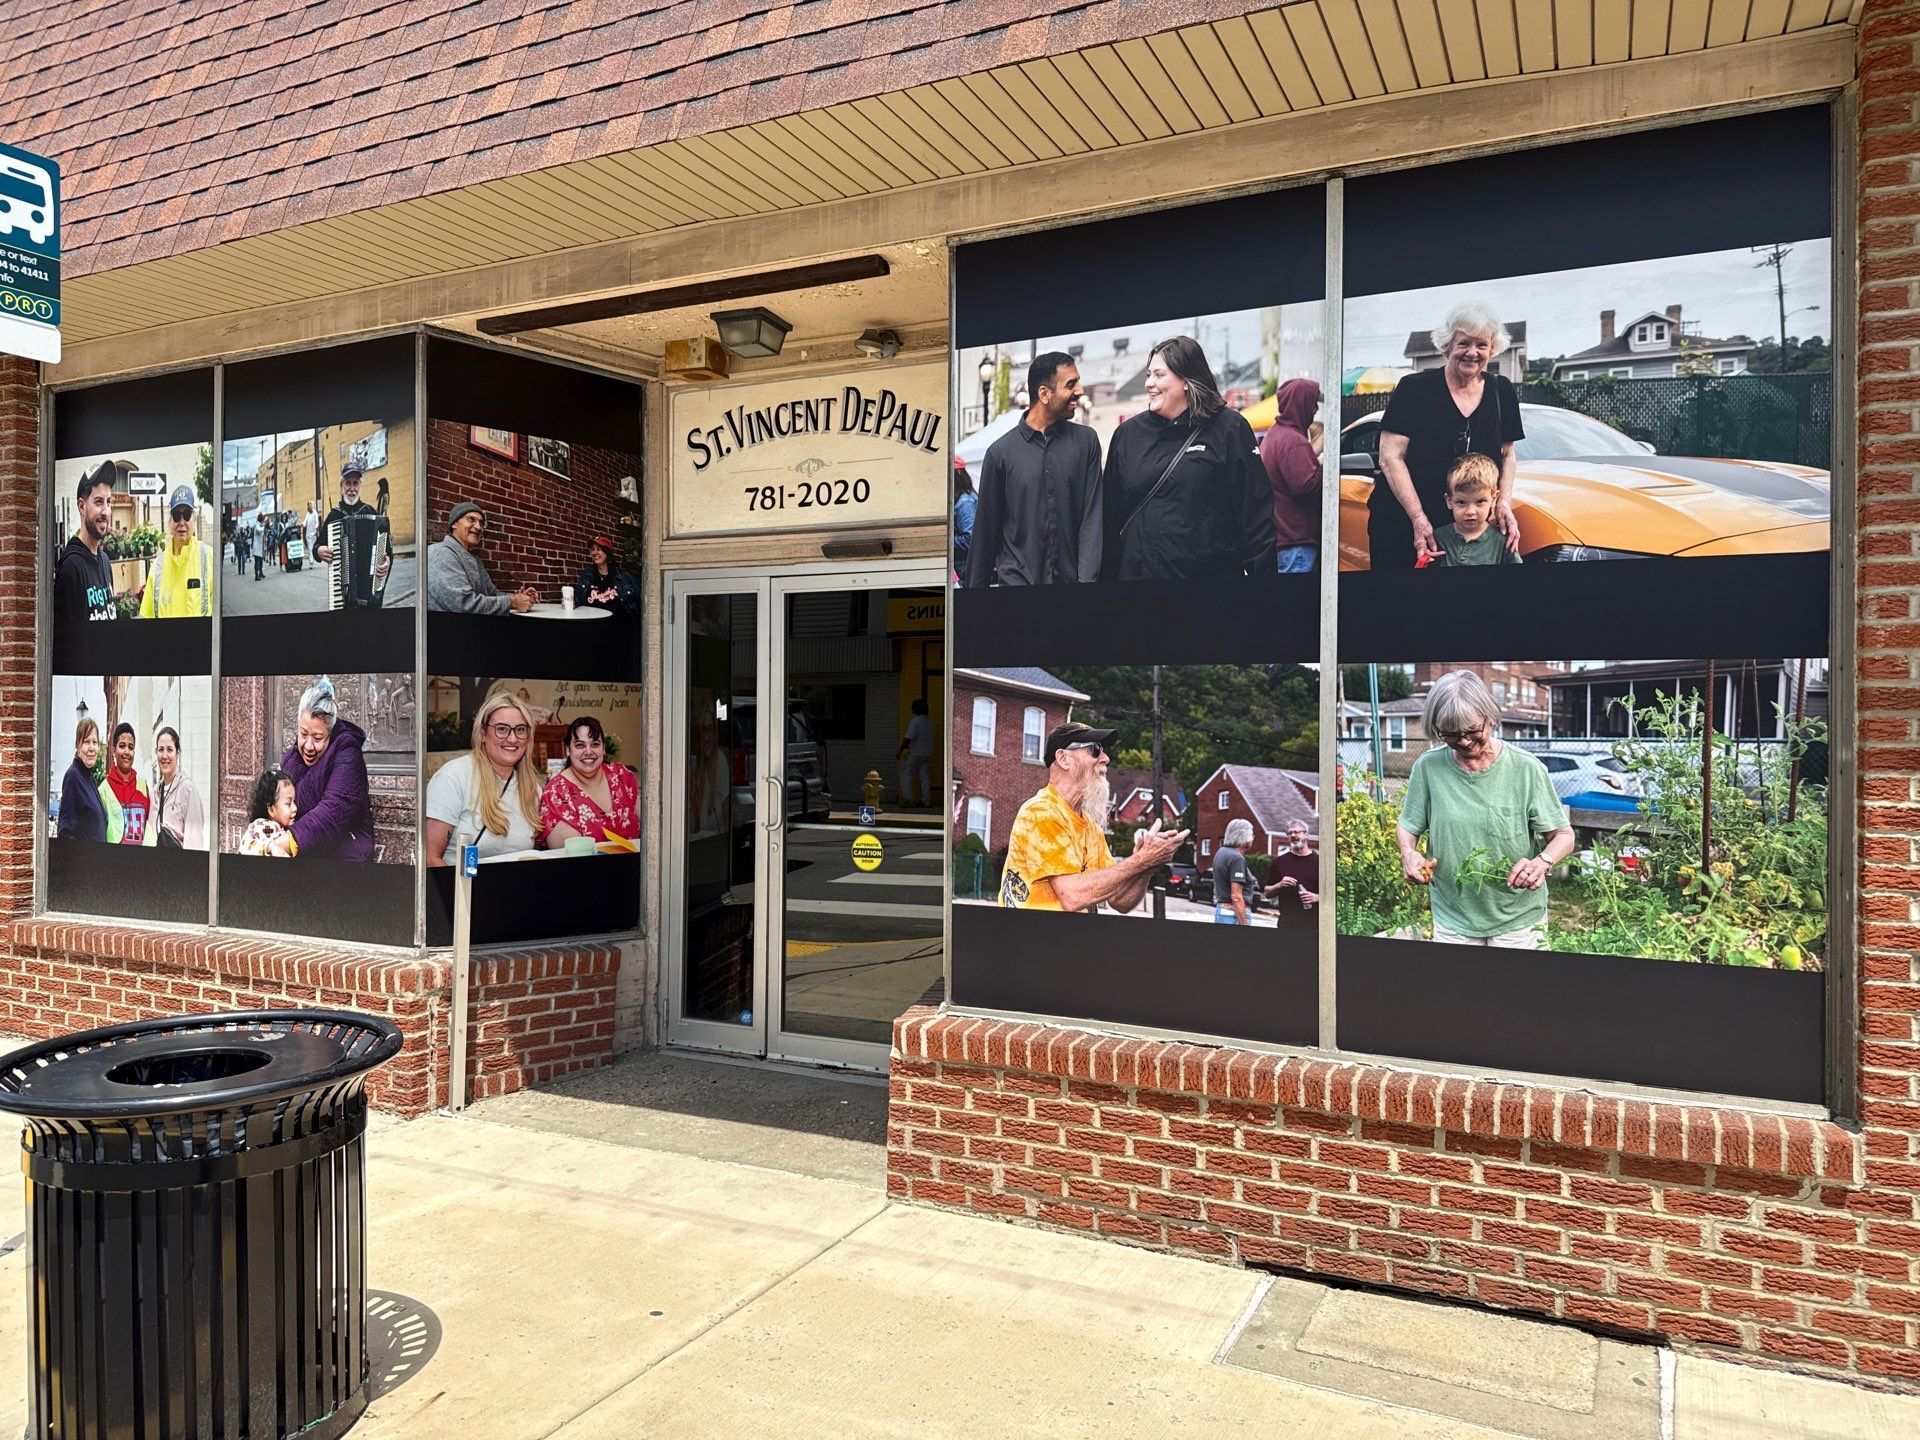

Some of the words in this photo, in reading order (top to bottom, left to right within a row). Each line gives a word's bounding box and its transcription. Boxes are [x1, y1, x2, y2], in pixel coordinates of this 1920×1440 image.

[7, 251, 18, 260] or
[20, 254, 37, 265] text
[9, 263, 20, 272] to
[21, 266, 50, 281] 41411
[744, 478, 871, 511] 781-2020
